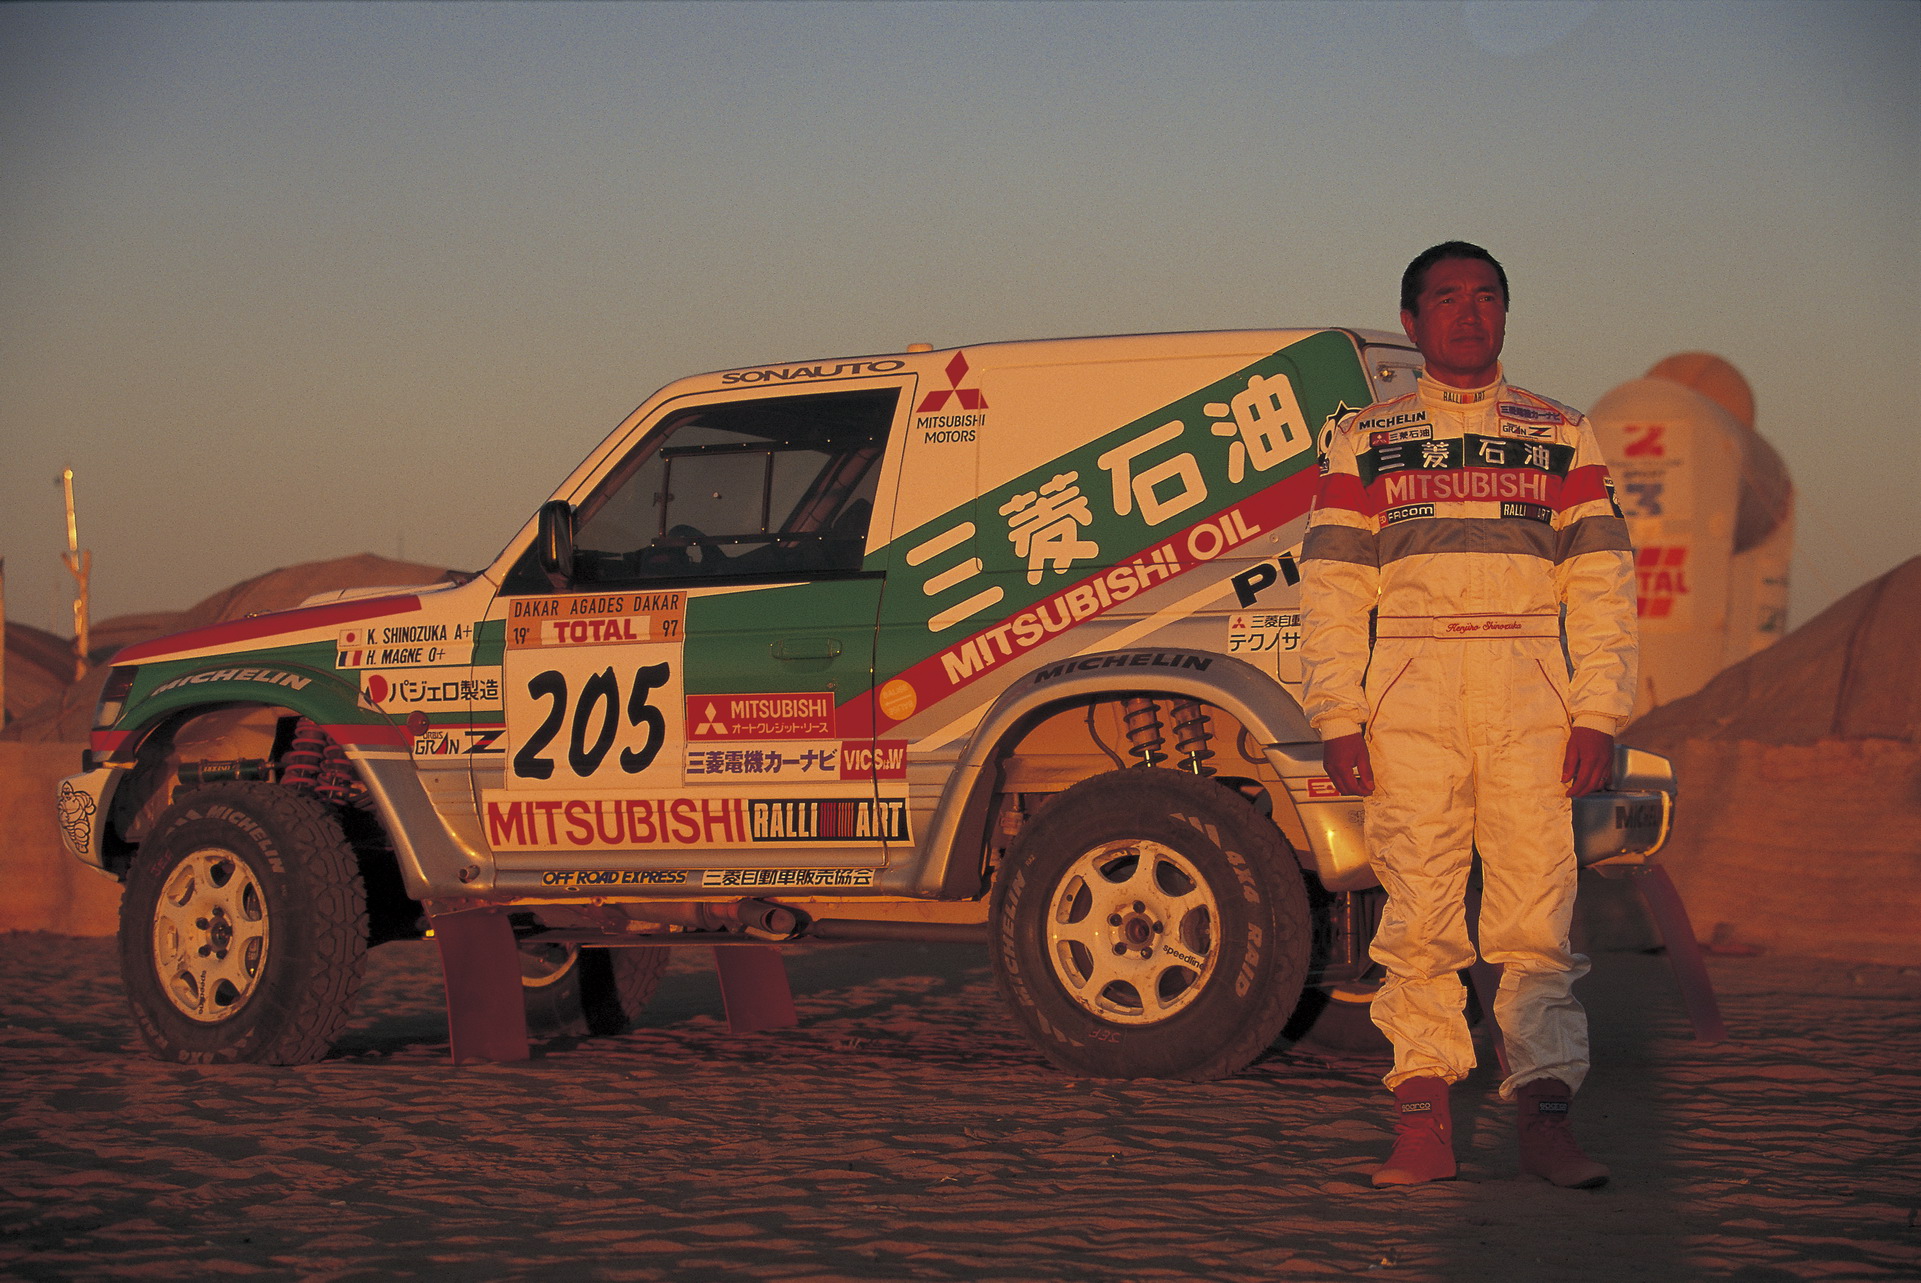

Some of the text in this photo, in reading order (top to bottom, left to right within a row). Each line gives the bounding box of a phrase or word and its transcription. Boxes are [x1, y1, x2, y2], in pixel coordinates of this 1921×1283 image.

[722, 360, 905, 384] SONAUTO
[1443, 391, 1485, 404] RALLI ART
[916, 414, 985, 429] MITSUBISHI
[1359, 411, 1426, 430] MICHELIN
[924, 430, 976, 444] MOTORS
[1390, 429, 1430, 443] 三菱石油
[1378, 438, 1550, 471] 三菱石油
[1385, 472, 1547, 504] MITSUBISHI
[906, 373, 1313, 632] 三菱石油
[1503, 504, 1526, 517] RALLI
[514, 594, 678, 617] DAKAR AGADES DAKAR
[940, 544, 1181, 686] MITSUBISHI
[1187, 509, 1261, 560] OIL
[367, 624, 472, 645] K. SHINOZUKA A+
[553, 618, 637, 643] TOTAL
[662, 620, 678, 637] 97
[366, 650, 376, 665] H.
[381, 647, 422, 664] MAGNE
[1034, 653, 1213, 684] MICHELIN
[151, 668, 312, 697] MICHELIN
[389, 679, 499, 702] パジェロ製造
[514, 662, 670, 780] 205
[731, 699, 827, 719] MITSUBISHI
[415, 733, 459, 754] GRAN
[687, 749, 838, 774] 三菱電機カーナビ
[487, 798, 747, 847] MITSUBISHI
[754, 802, 903, 838] RALLI ART
[206, 804, 285, 873] MICHELIN
[543, 871, 686, 885] OFF ROAD EXPRESS
[1003, 871, 1034, 1006] MICHELIN
[1235, 921, 1263, 998] RAID
